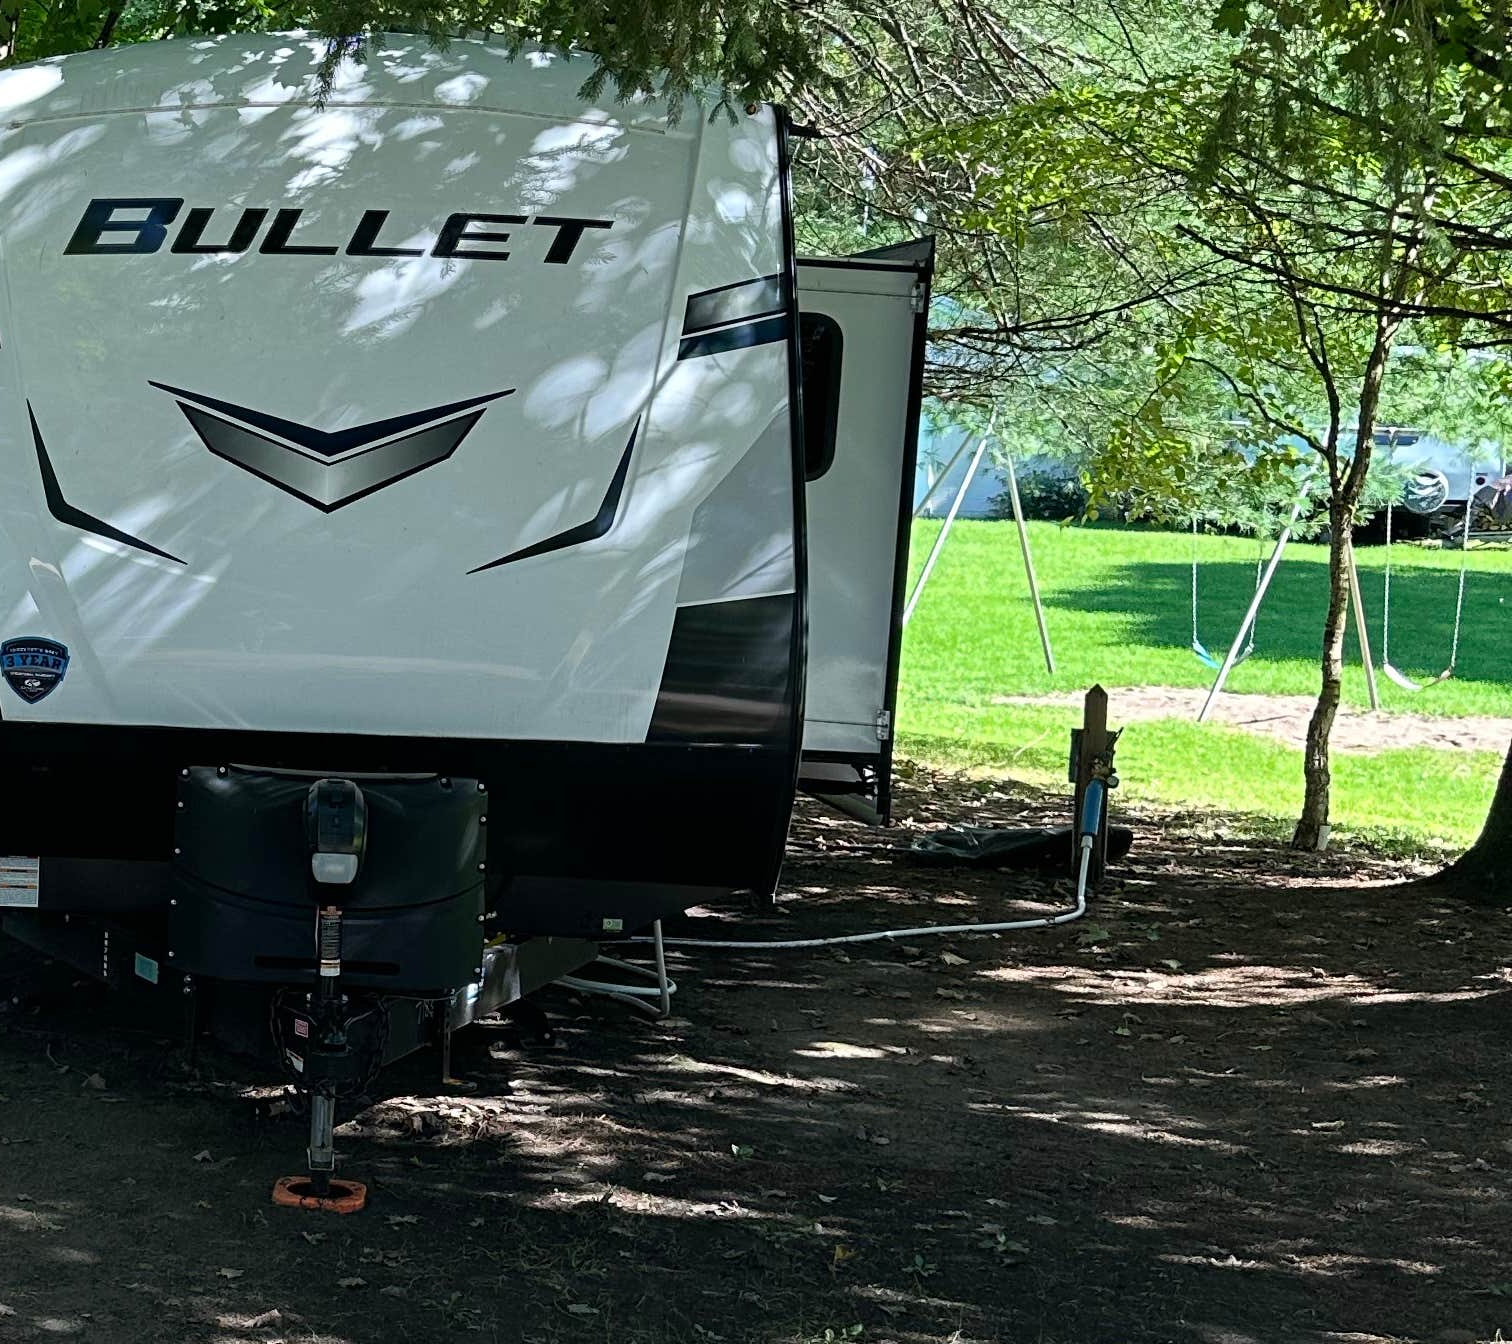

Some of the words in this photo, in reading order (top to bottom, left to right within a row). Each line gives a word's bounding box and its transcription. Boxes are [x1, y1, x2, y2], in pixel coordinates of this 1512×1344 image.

[63, 197, 615, 265] BULLET
[5, 655, 15, 668] 3
[21, 654, 62, 670] YEAR
